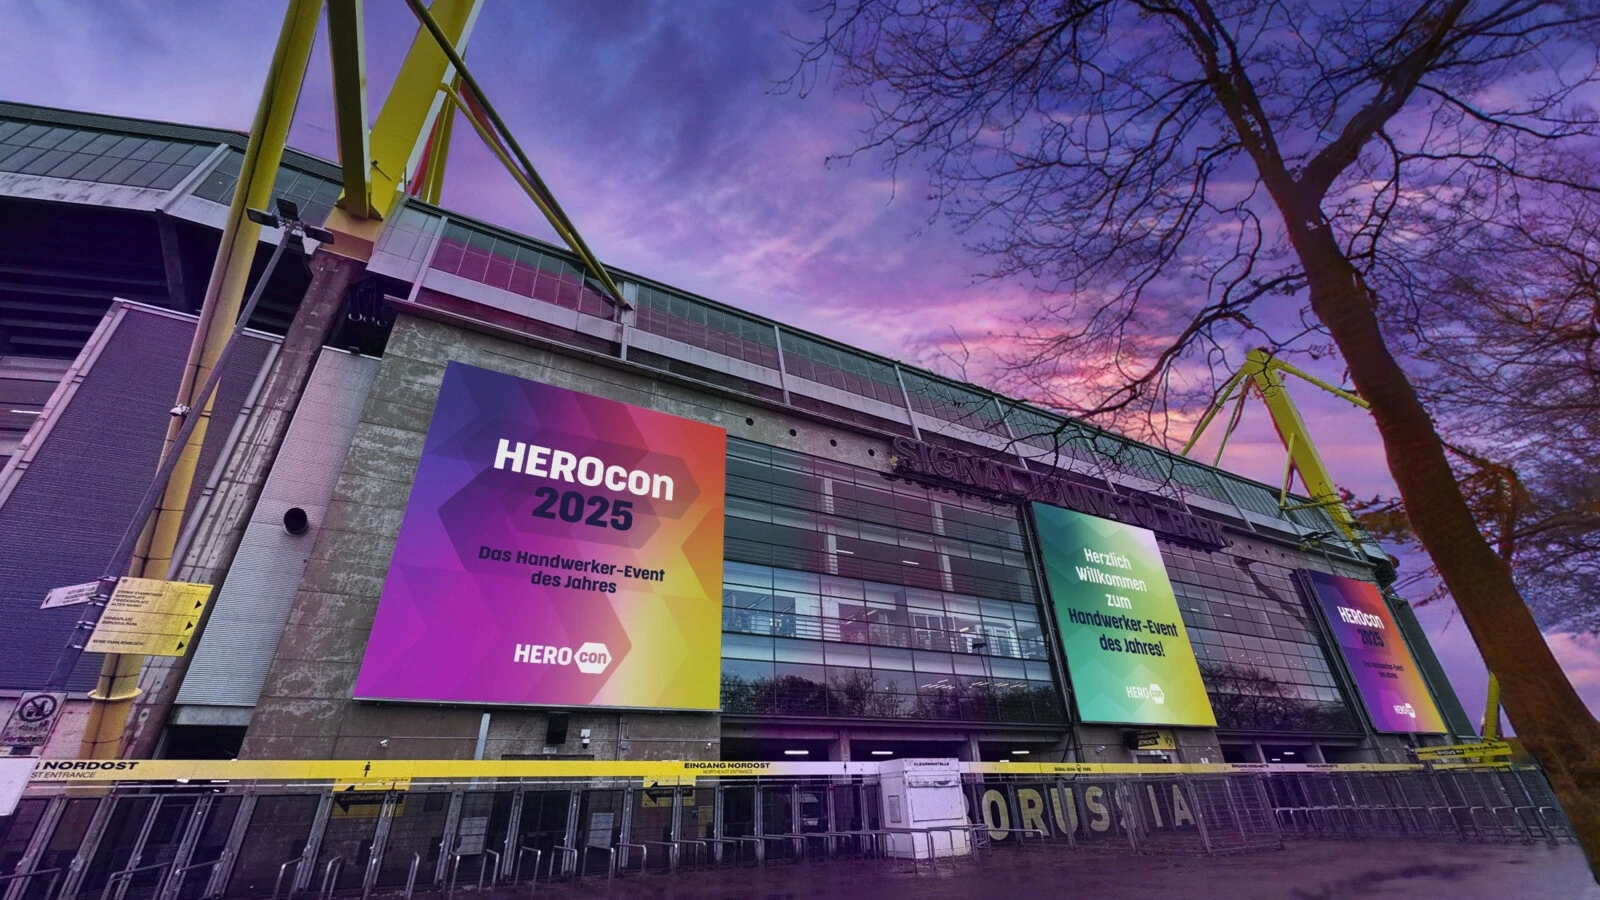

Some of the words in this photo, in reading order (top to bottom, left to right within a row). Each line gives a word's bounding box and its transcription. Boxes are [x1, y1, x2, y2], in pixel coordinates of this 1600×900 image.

[494, 438, 674, 501] HEROcon
[532, 486, 633, 531] 2025
[478, 545, 512, 562] Das
[516, 550, 665, 582] Handwerker-Event
[1083, 547, 1132, 570] Herzlich
[531, 571, 561, 587] des
[565, 575, 617, 593] Jahres
[1075, 566, 1148, 592] Willkommen
[1105, 593, 1133, 610] zum
[1067, 607, 1179, 637] Handwerker-Event
[1336, 606, 1385, 630] HEROcon
[514, 643, 573, 666] HERO
[579, 650, 607, 664] con
[1099, 634, 1122, 651] des
[1124, 637, 1166, 657] Jahres!
[1125, 686, 1149, 700] HERO
[43, 761, 139, 770] NORDOST
[44, 771, 97, 779] ENTRANCE
